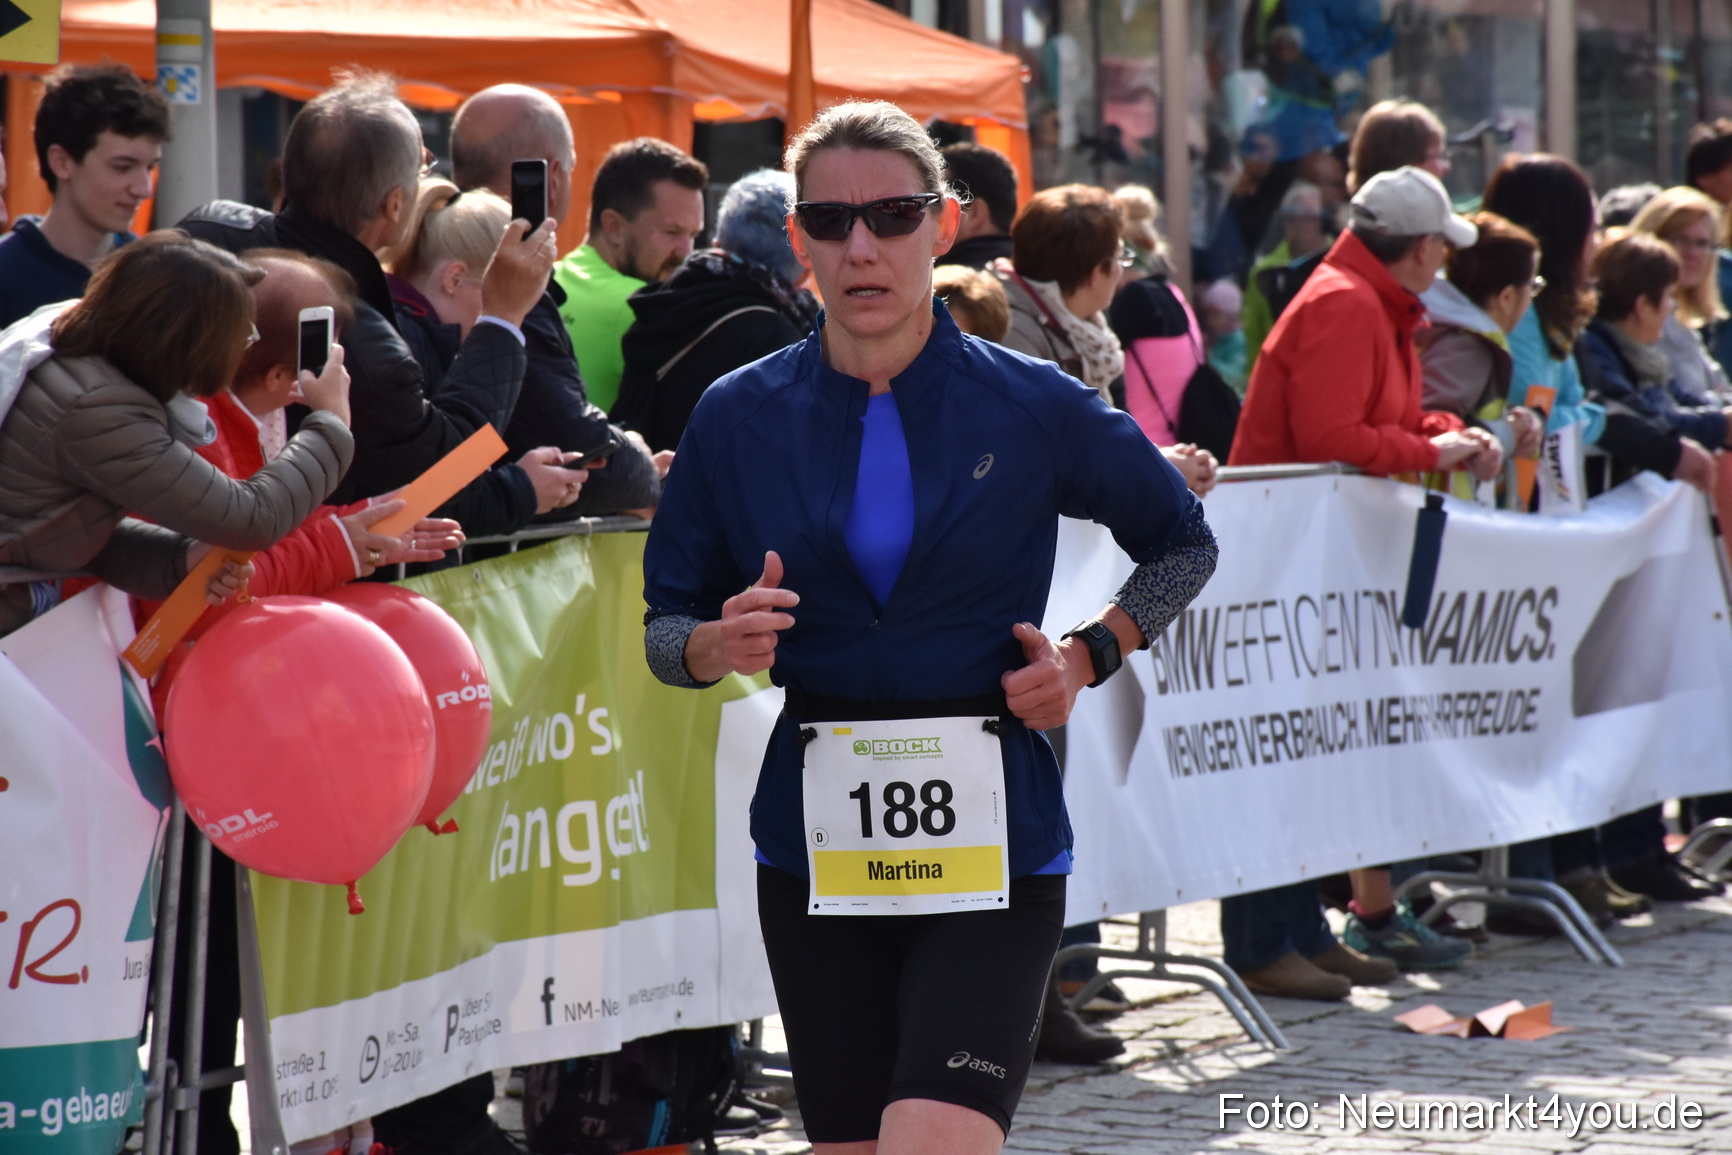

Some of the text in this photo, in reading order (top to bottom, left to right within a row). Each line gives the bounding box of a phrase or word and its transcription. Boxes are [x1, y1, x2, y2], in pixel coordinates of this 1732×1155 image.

[1151, 606, 1220, 695] BMW
[528, 694, 613, 767] wo's
[1162, 718, 1243, 779] WENIGER
[1239, 701, 1363, 767] VERBRAUCH.
[872, 737, 942, 756] BOCK
[873, 754, 893, 762] inspired
[849, 779, 956, 839] 188
[816, 832, 823, 843] D
[867, 860, 943, 880] Martina
[123, 956, 142, 981] Jura
[276, 1050, 327, 1081] straße 1
[968, 1057, 1006, 1080] asics
